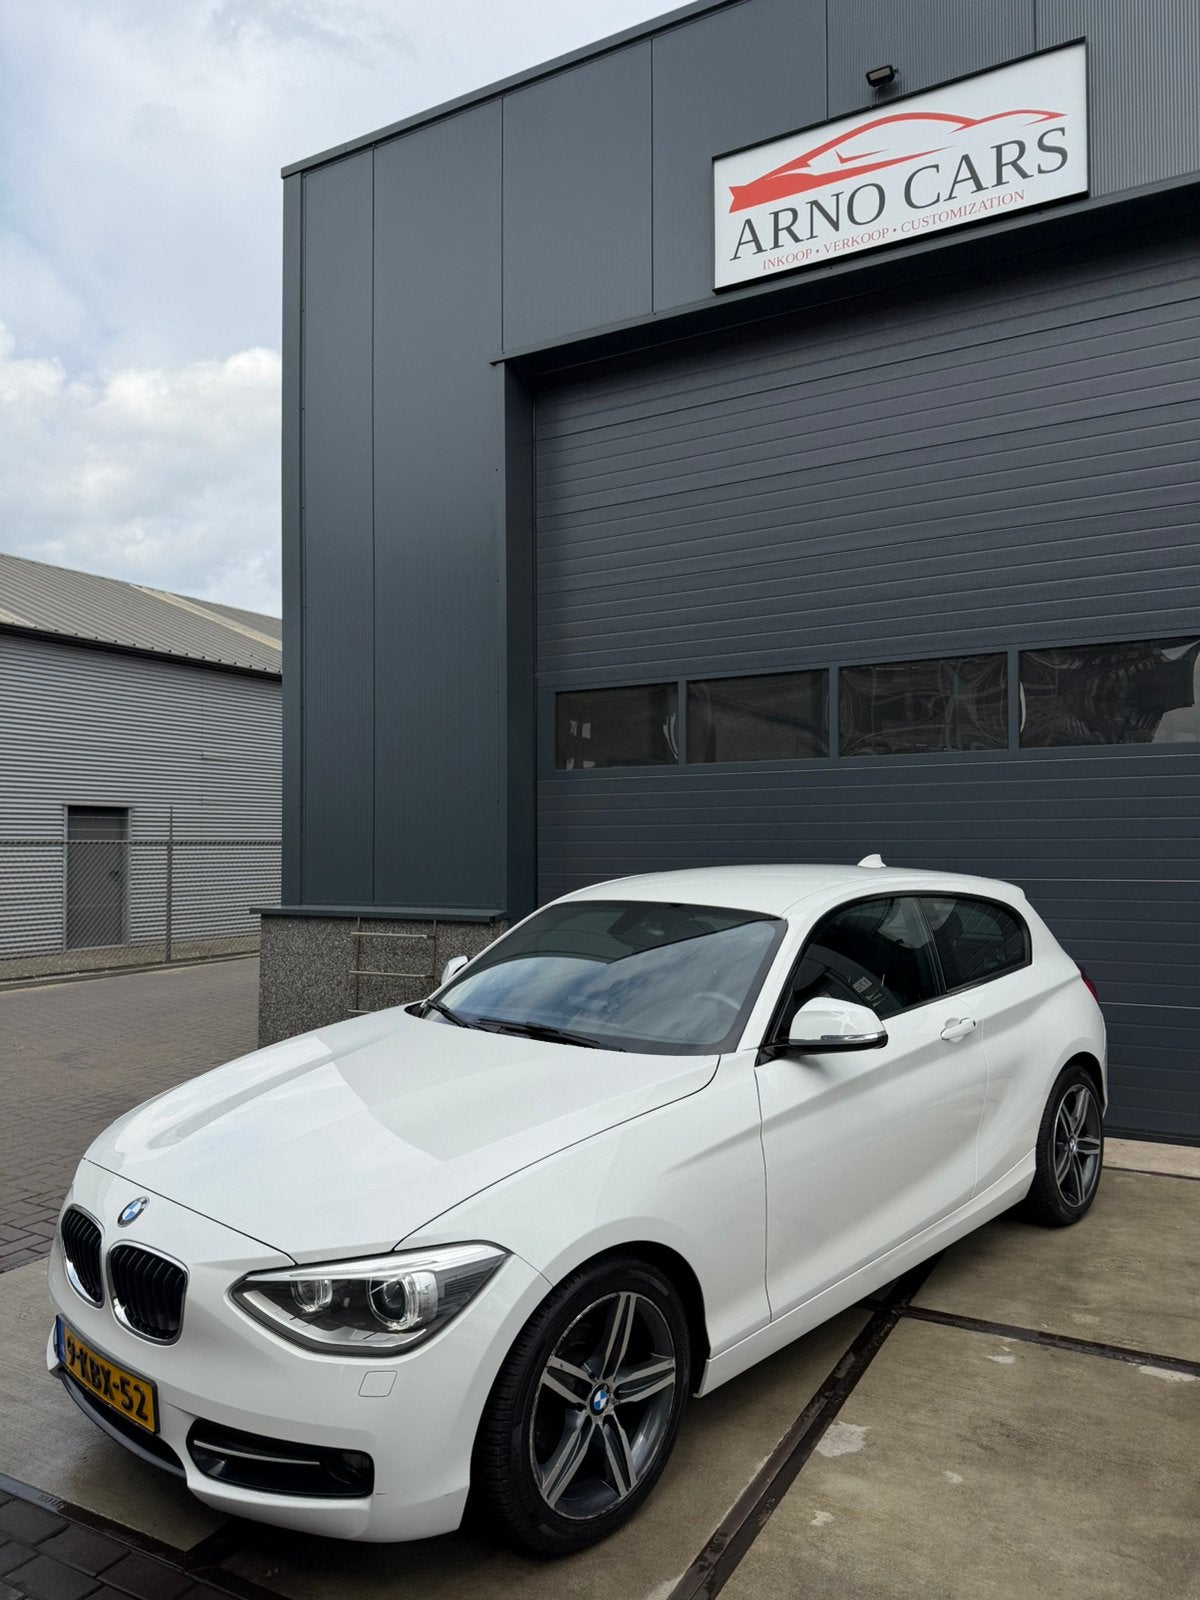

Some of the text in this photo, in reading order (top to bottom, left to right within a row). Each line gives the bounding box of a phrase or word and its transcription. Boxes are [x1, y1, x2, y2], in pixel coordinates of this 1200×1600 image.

[730, 126, 1068, 261] ARNO CARS
[762, 189, 1025, 271] INKOOP VERKOOP CUSTOMIZATION
